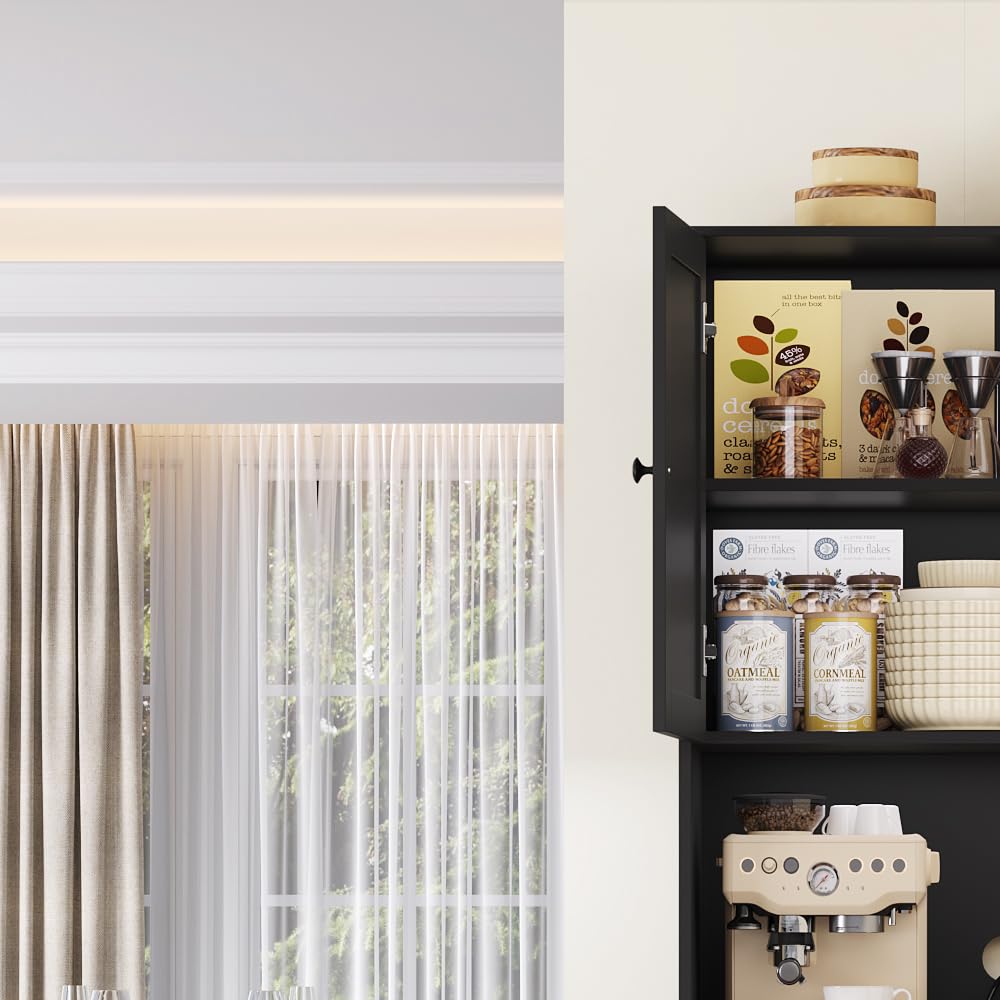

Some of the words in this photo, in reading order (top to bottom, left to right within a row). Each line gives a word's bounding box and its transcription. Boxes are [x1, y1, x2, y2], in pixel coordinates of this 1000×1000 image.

[858, 444, 866, 453] 3
[723, 463, 739, 474] &
[747, 543, 770, 554] Fibre
[771, 543, 796, 554] flakes
[843, 543, 865, 554] Fibre
[866, 543, 891, 554] flakes
[725, 631, 778, 665] Organic
[812, 633, 863, 667] Organic
[726, 667, 780, 678] OATMEAL
[813, 668, 867, 679] CORNMEAL
